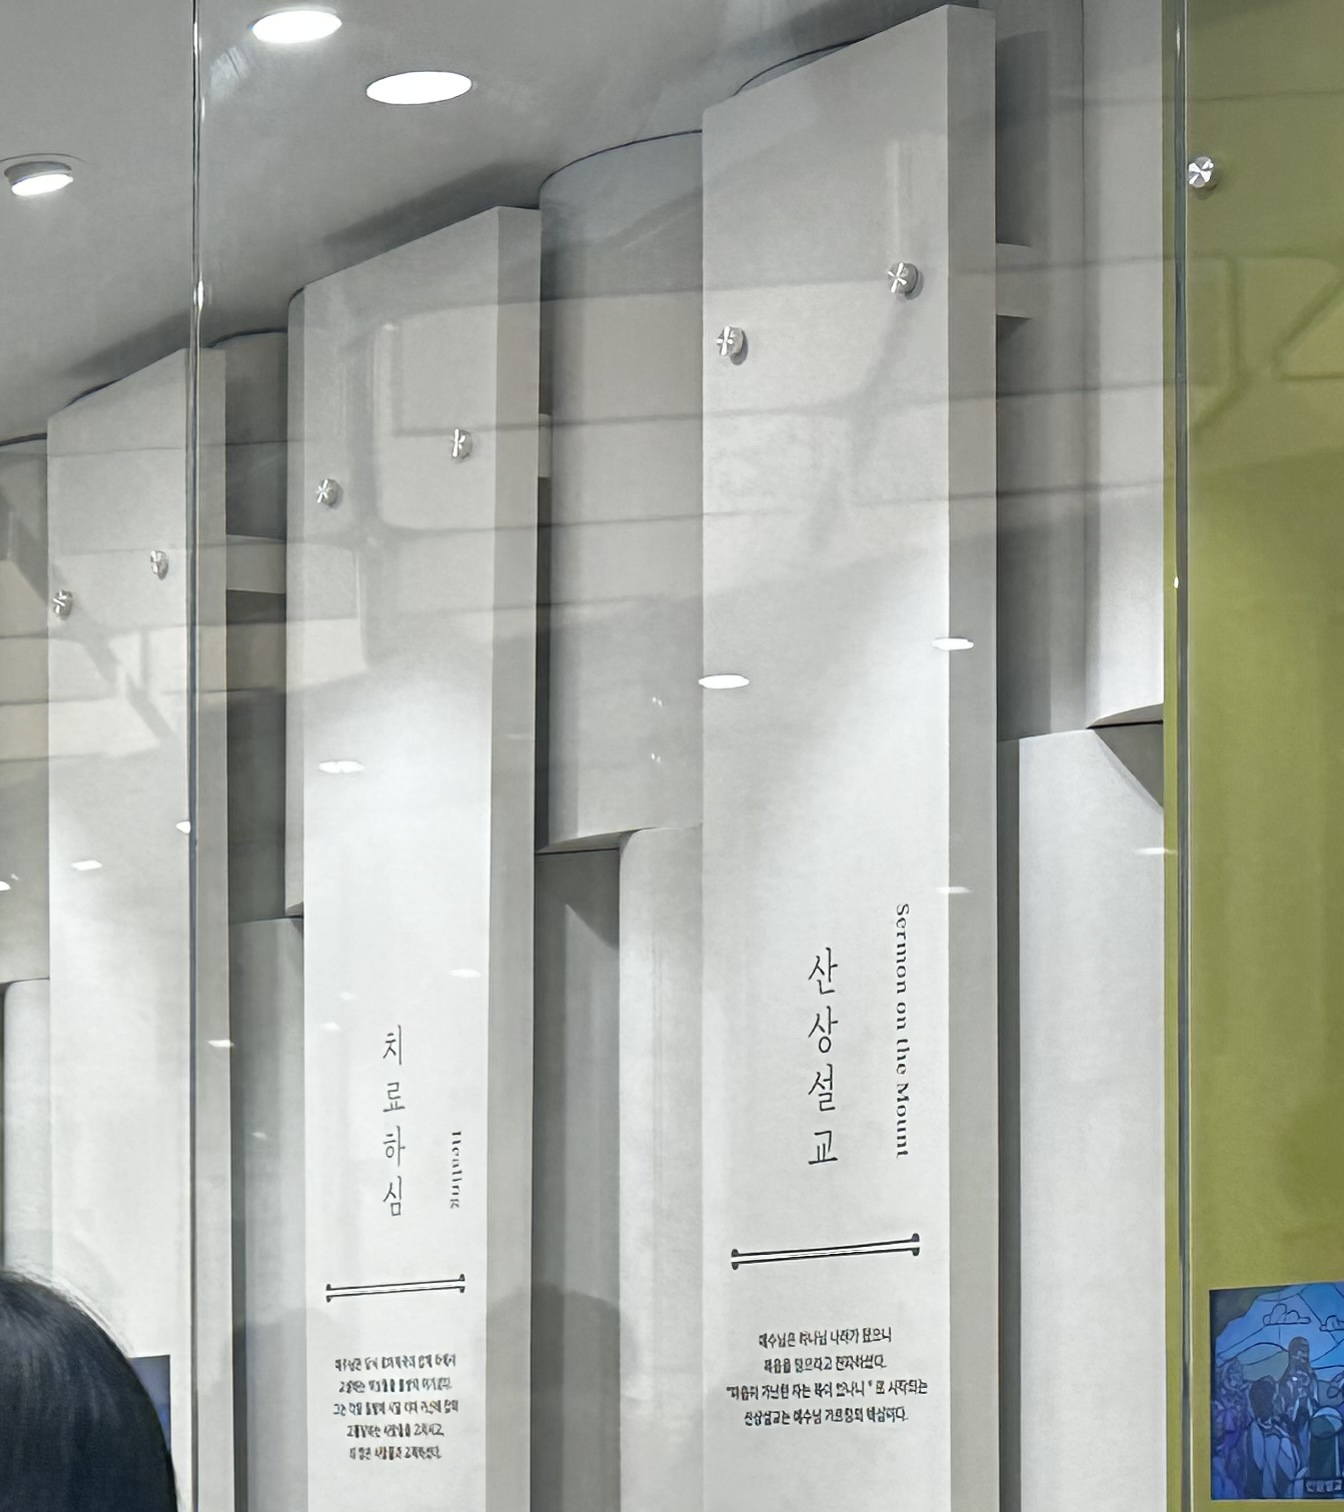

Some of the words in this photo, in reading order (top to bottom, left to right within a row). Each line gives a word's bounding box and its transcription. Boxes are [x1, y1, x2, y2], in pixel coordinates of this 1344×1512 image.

[896, 904, 909, 994] Sermon
[808, 947, 838, 1165] 산상설교
[896, 1039, 910, 1075] the
[897, 1002, 906, 1030] on
[383, 1025, 406, 1216] 치료하심
[896, 1083, 909, 1158] Mount
